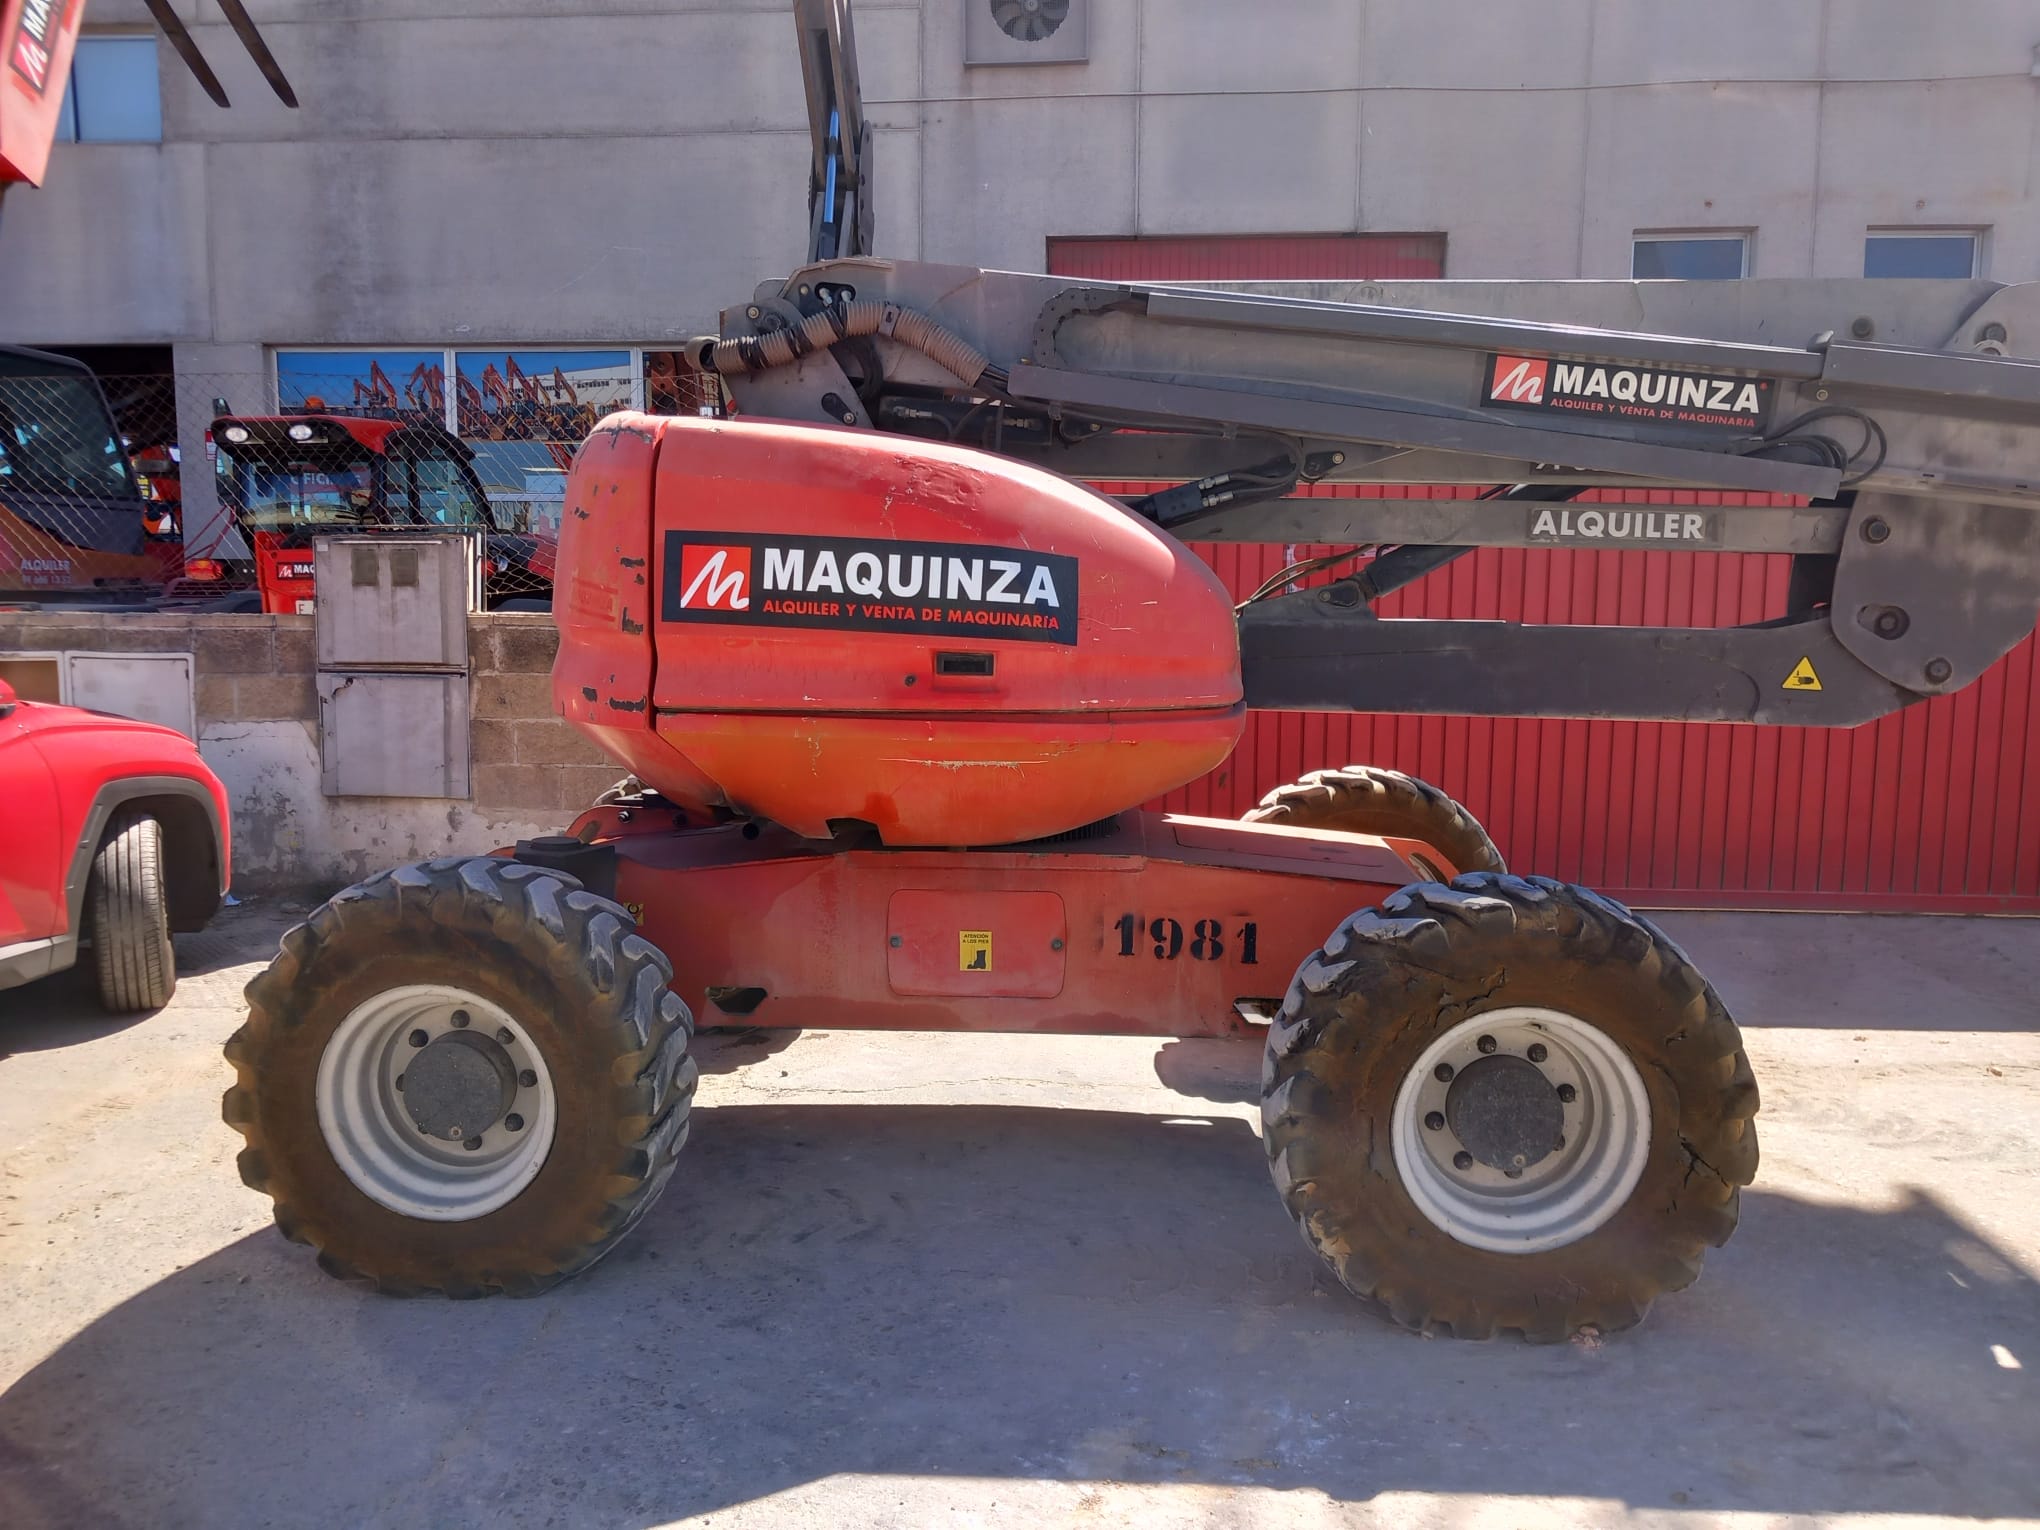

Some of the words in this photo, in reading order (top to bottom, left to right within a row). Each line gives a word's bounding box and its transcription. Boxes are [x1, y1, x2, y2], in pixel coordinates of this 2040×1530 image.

[1552, 364, 1760, 413] MAQUINZA
[1550, 398, 1603, 412] ALQUILER
[1608, 404, 1616, 413] Y
[1619, 405, 1656, 417] VENTA
[1660, 410, 1673, 419] DE
[1678, 412, 1756, 427] MAQUINARIA
[1532, 511, 1704, 539] ALQUILER
[763, 547, 1061, 608] MAQUINZA
[763, 600, 840, 616] ALQUILER
[845, 602, 856, 617] Y
[863, 604, 915, 621] VENTA
[922, 606, 942, 622] DE
[947, 610, 1060, 630] MAQUINARIA
[1114, 913, 1259, 964] 1981
